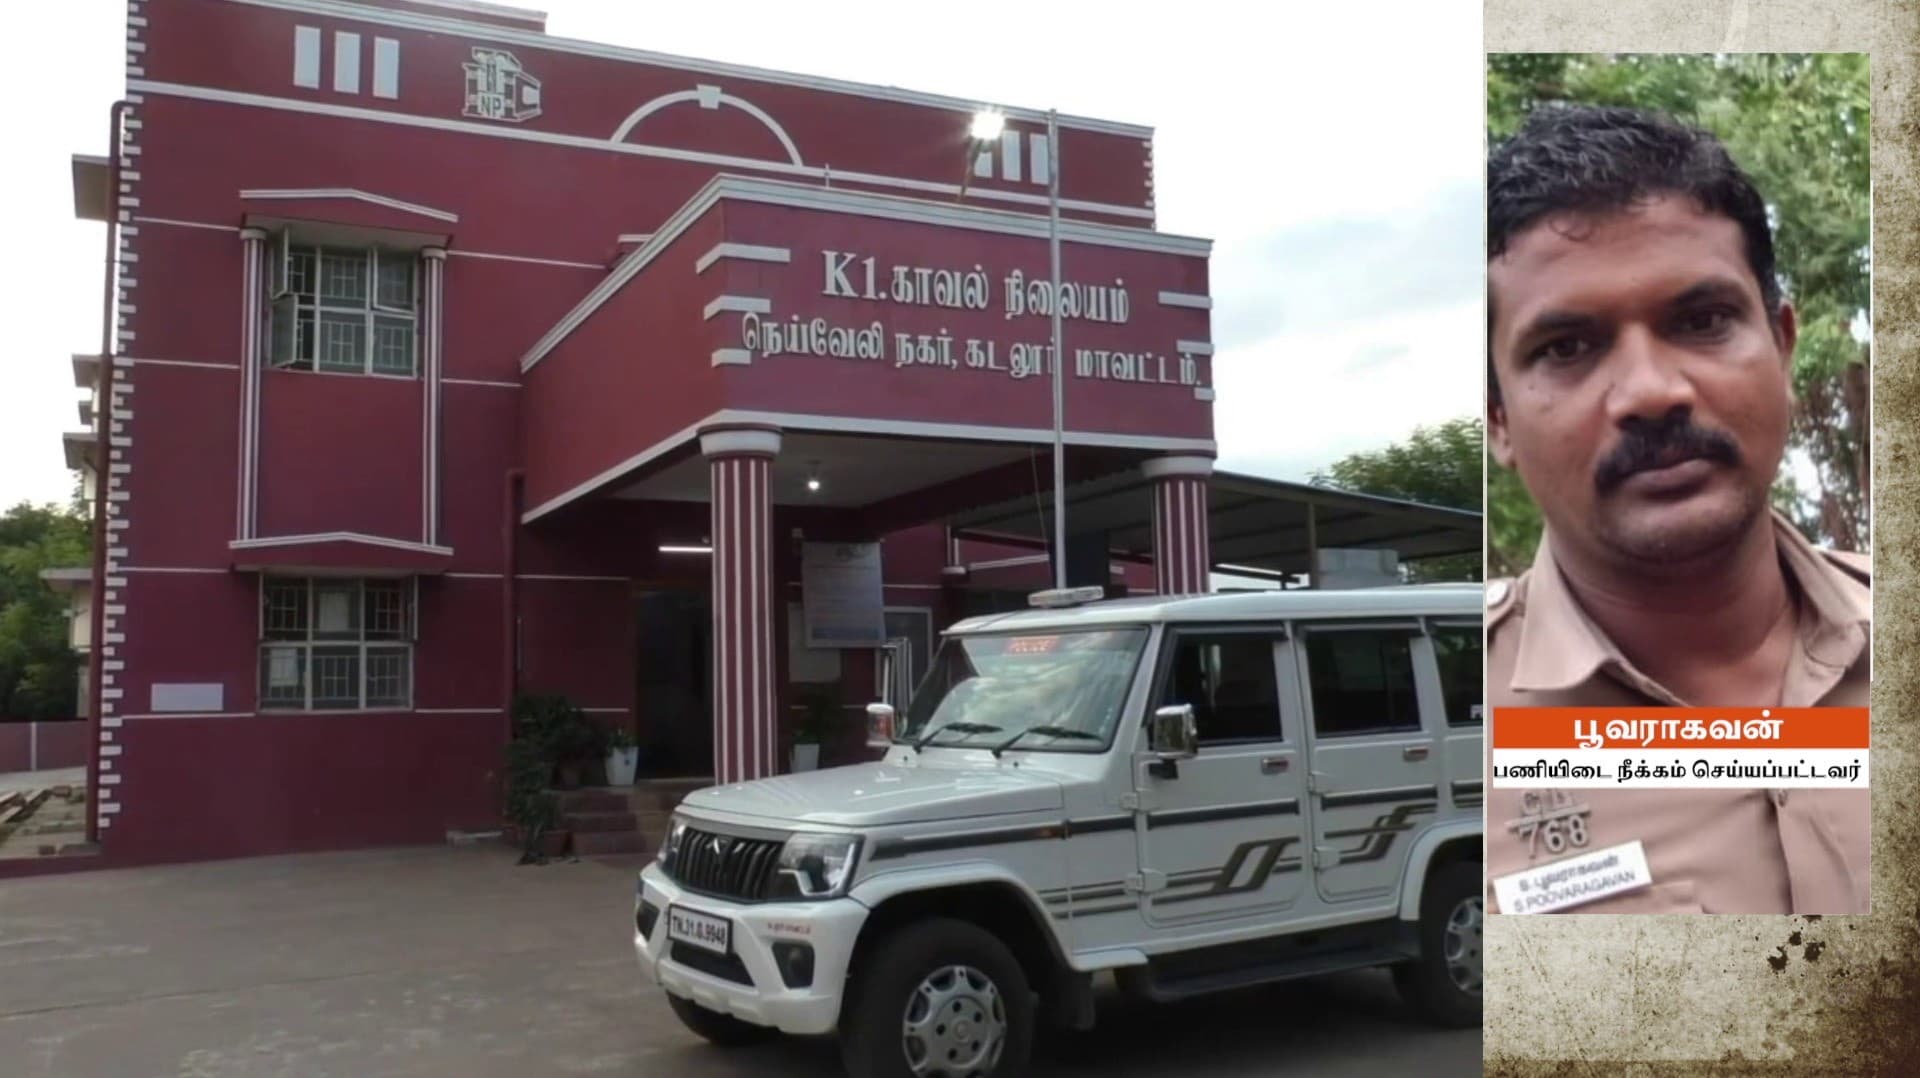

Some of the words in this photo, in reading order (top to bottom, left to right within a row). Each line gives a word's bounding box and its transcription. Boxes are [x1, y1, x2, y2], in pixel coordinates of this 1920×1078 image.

[1004, 268, 1130, 324] நிலையம்
[742, 311, 884, 360] நெய்வேலி
[1518, 814, 1588, 860] 768
